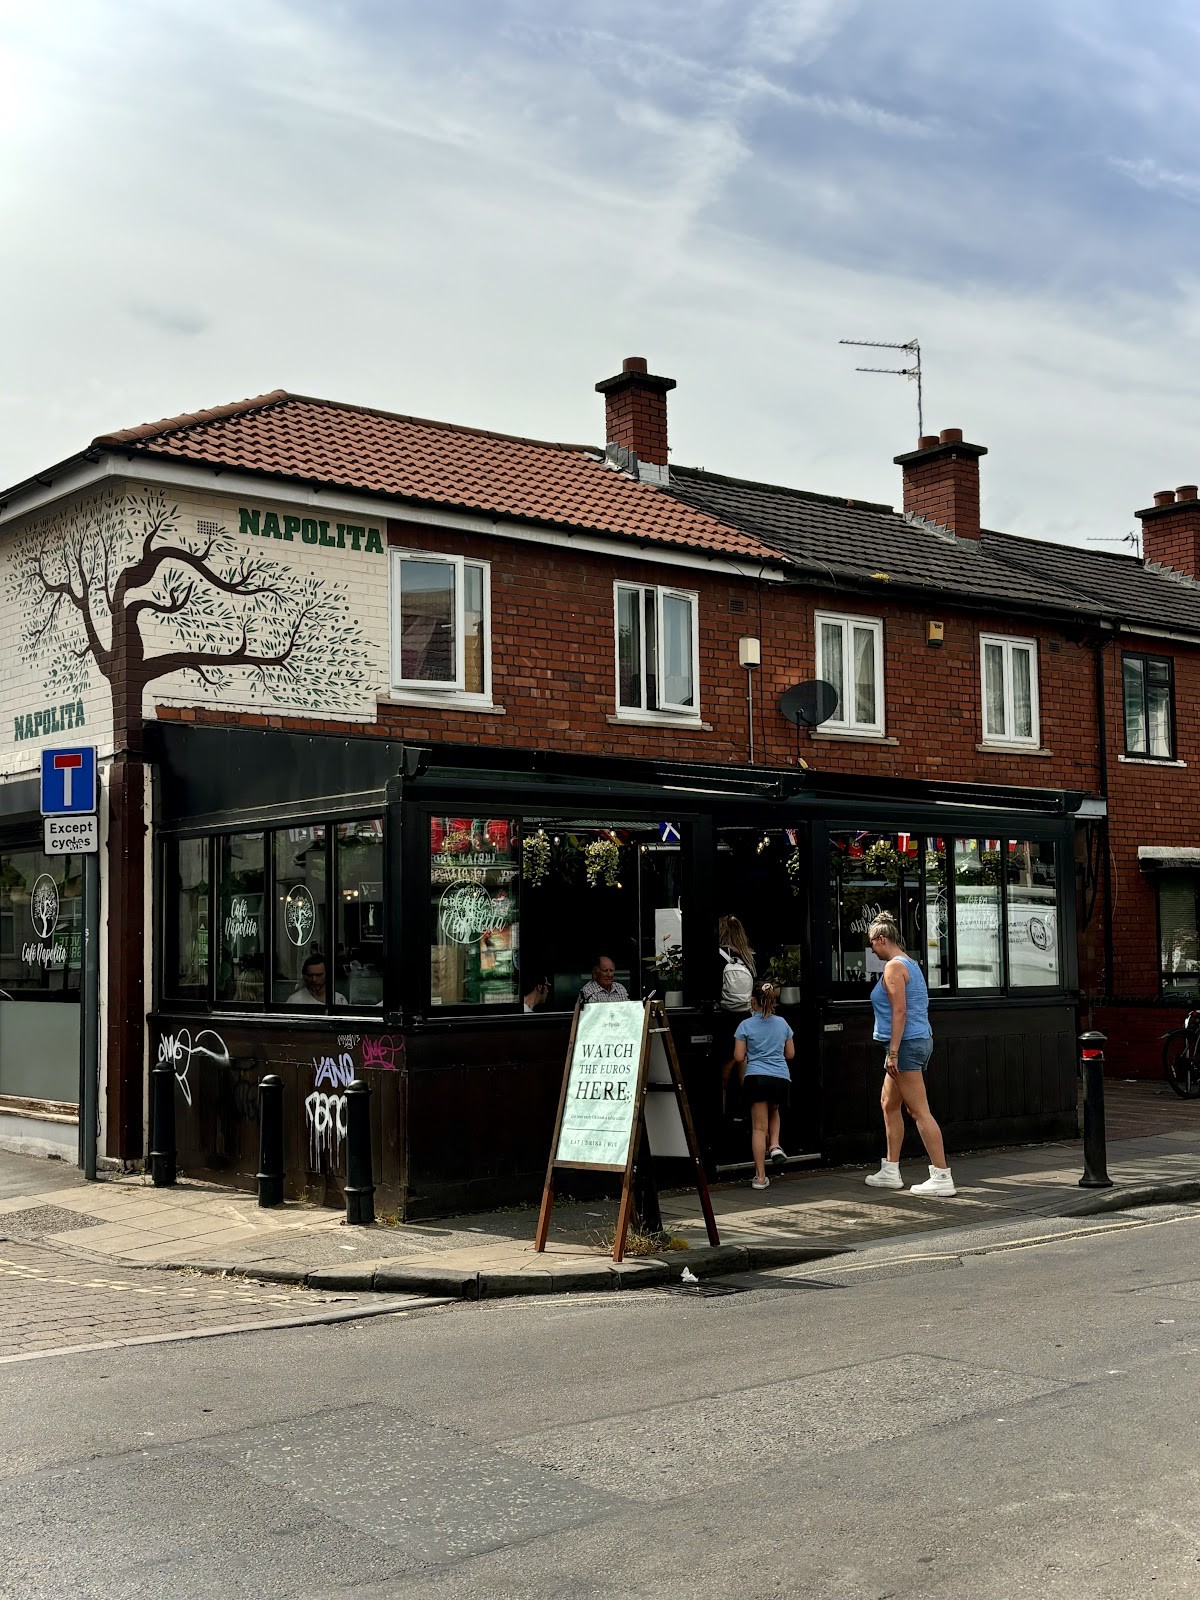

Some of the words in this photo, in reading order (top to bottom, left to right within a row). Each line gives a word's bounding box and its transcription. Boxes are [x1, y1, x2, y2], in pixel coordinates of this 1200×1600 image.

[238, 507, 384, 554] NAPOLITA
[14, 697, 86, 741] NAPOLITA
[50, 821, 93, 835] Except
[51, 836, 91, 850] cycles
[231, 898, 247, 922] Café
[225, 916, 259, 943] Napolita
[22, 942, 37, 966] Café
[37, 942, 67, 969] Napolita
[582, 1043, 634, 1058] WATCH
[579, 1064, 598, 1075] THE
[600, 1064, 631, 1075] EUROS
